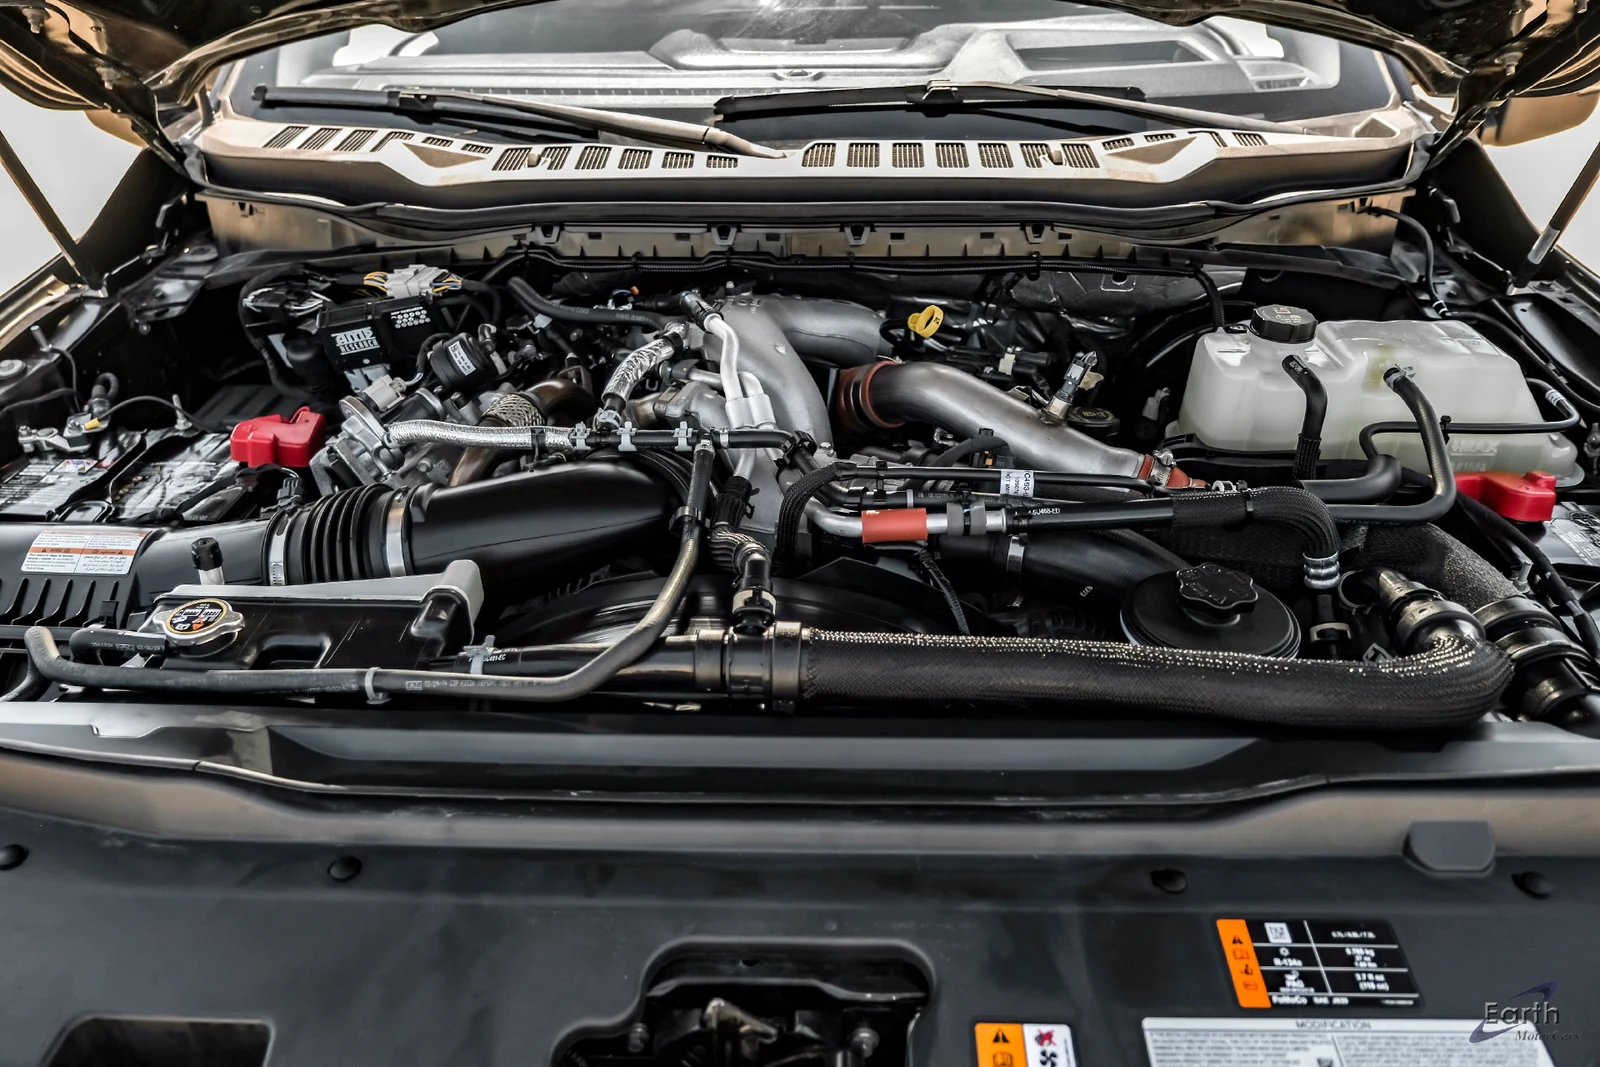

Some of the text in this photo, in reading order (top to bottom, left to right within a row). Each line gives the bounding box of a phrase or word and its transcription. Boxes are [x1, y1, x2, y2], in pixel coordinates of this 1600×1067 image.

[339, 338, 379, 354] RESEARCH
[1273, 957, 1303, 967] R-134a
[1295, 1019, 1372, 1029] MODIFICATION
